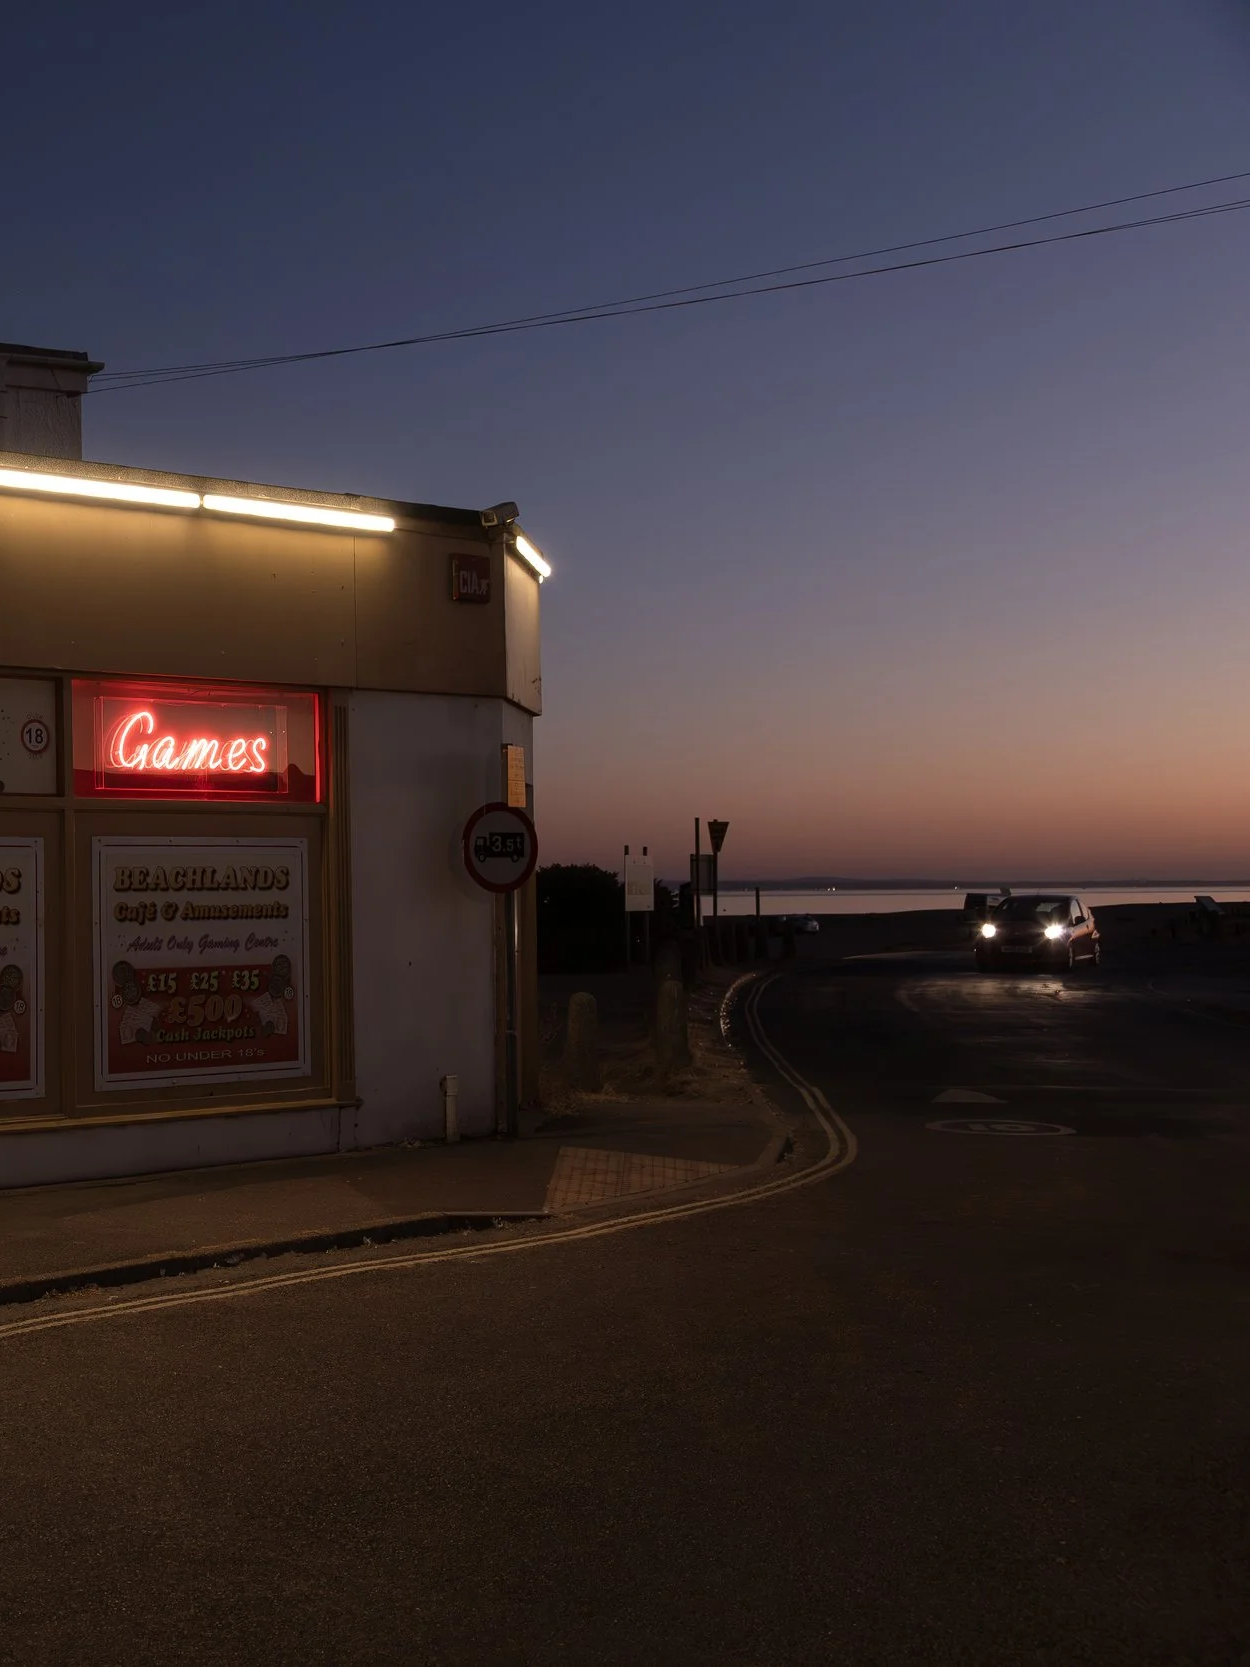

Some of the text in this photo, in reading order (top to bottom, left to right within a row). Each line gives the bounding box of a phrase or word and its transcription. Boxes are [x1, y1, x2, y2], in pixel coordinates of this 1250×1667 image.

[26, 728, 43, 744] 18
[118, 711, 267, 773] Games
[491, 835, 523, 853] 3.5t
[114, 866, 290, 892] BEACHLANDS
[114, 900, 289, 925] Café & Amusements
[167, 935, 194, 955] Only
[198, 933, 240, 955] Gaming
[244, 932, 279, 951] Centre
[146, 968, 261, 995] £15 £25 £35
[15, 1000, 25, 1013] 18
[166, 994, 244, 1027] £500
[155, 1025, 256, 1044] Cash Jackpots
[146, 1053, 172, 1064] NO
[175, 1049, 233, 1061] UNDER
